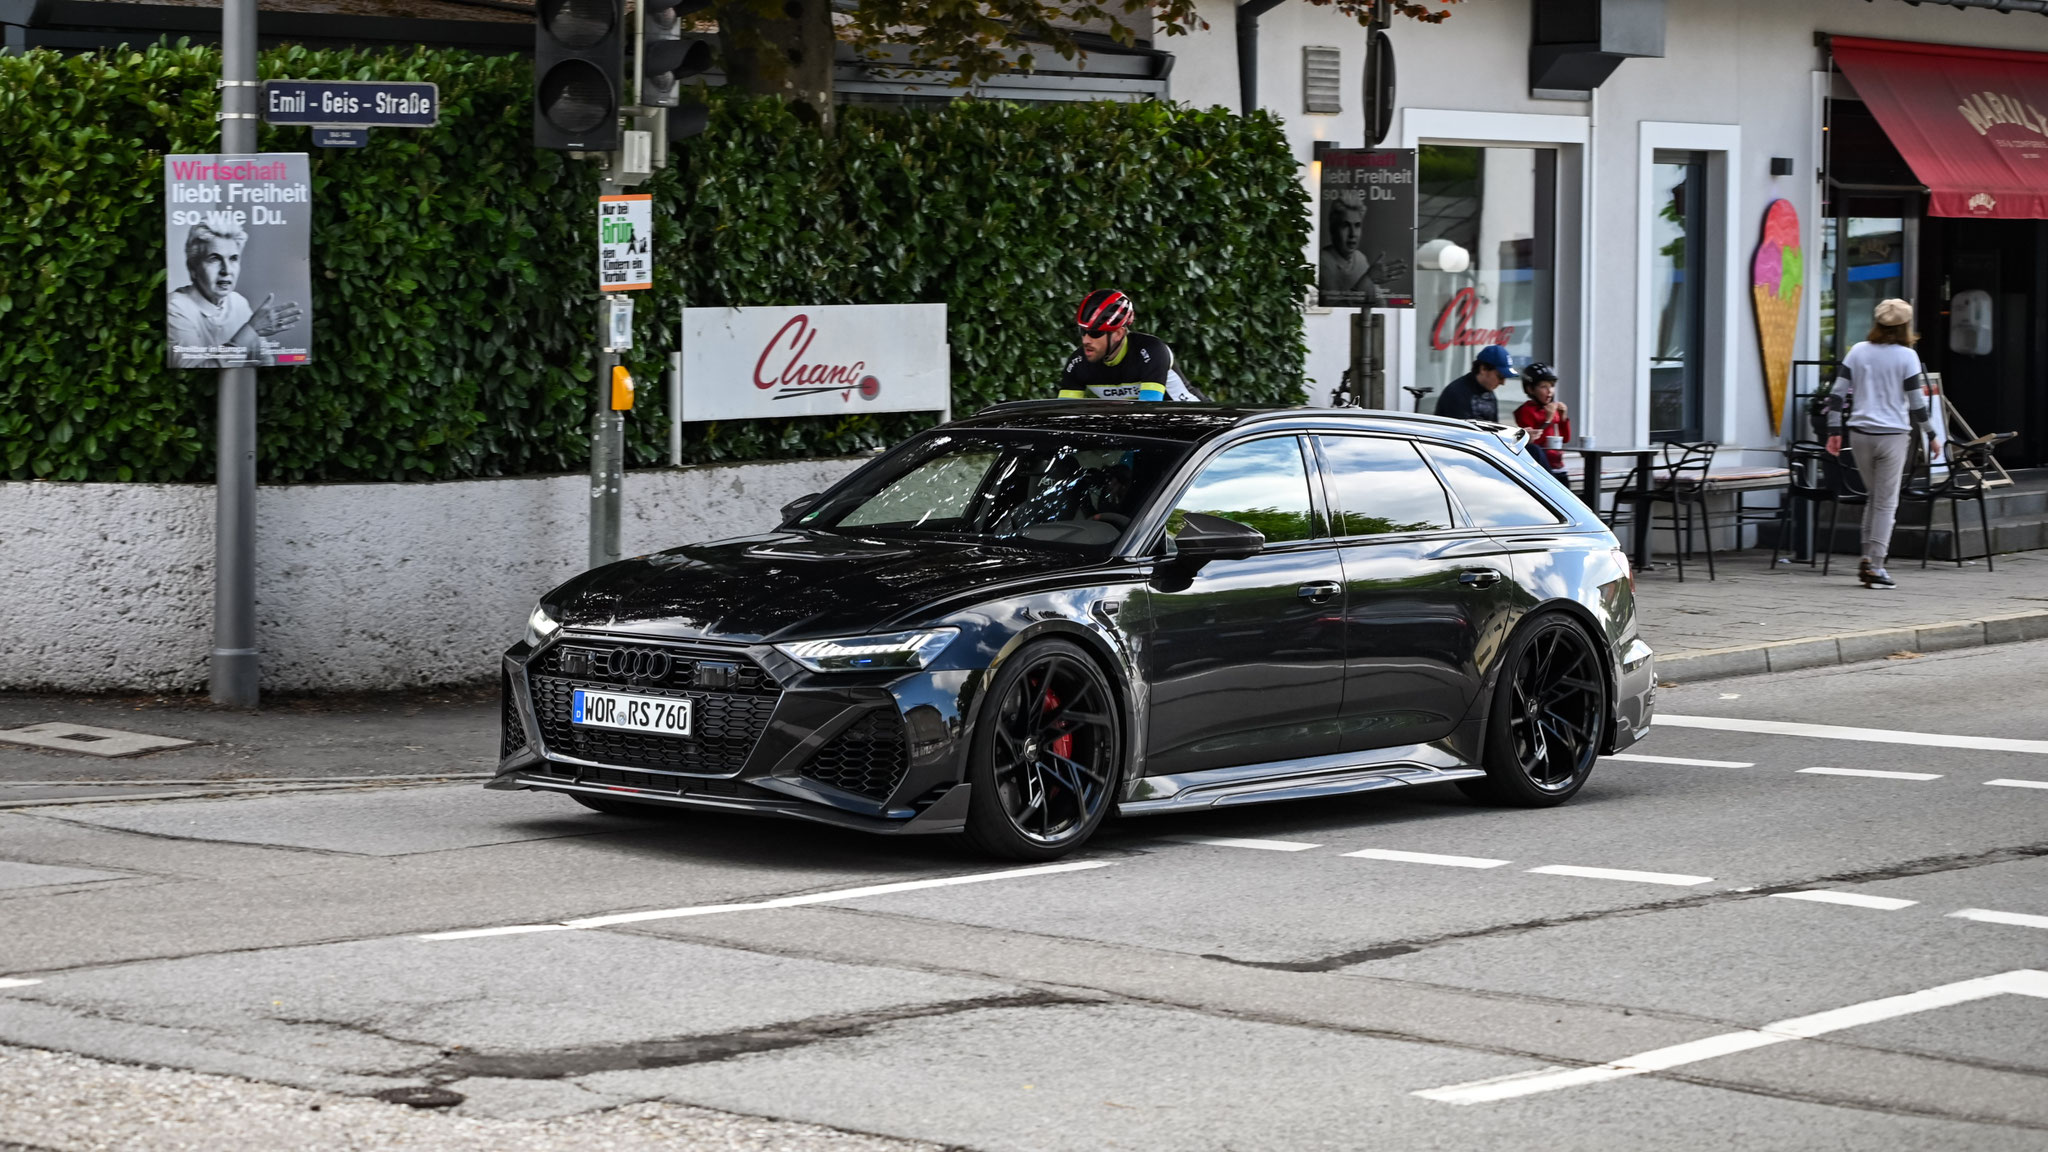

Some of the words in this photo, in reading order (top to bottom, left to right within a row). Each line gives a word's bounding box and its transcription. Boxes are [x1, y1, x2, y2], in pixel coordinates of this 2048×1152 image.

[269, 90, 306, 113] Emil
[322, 91, 359, 113] Geis
[375, 91, 431, 114] Straße
[172, 160, 287, 181] Wirtschaft
[1354, 168, 1412, 184] Freiheit
[172, 183, 222, 203] liebt
[228, 183, 308, 203] Freiheit
[1370, 185, 1396, 201] Du.
[172, 210, 201, 226] so
[206, 205, 247, 226] wie
[251, 205, 288, 226] Du.
[602, 204, 615, 216] Nur
[602, 217, 634, 244] Grün
[1103, 387, 1132, 397] CRAFT
[585, 696, 616, 723] WOR
[627, 700, 651, 727] RS
[654, 703, 688, 730] 760
